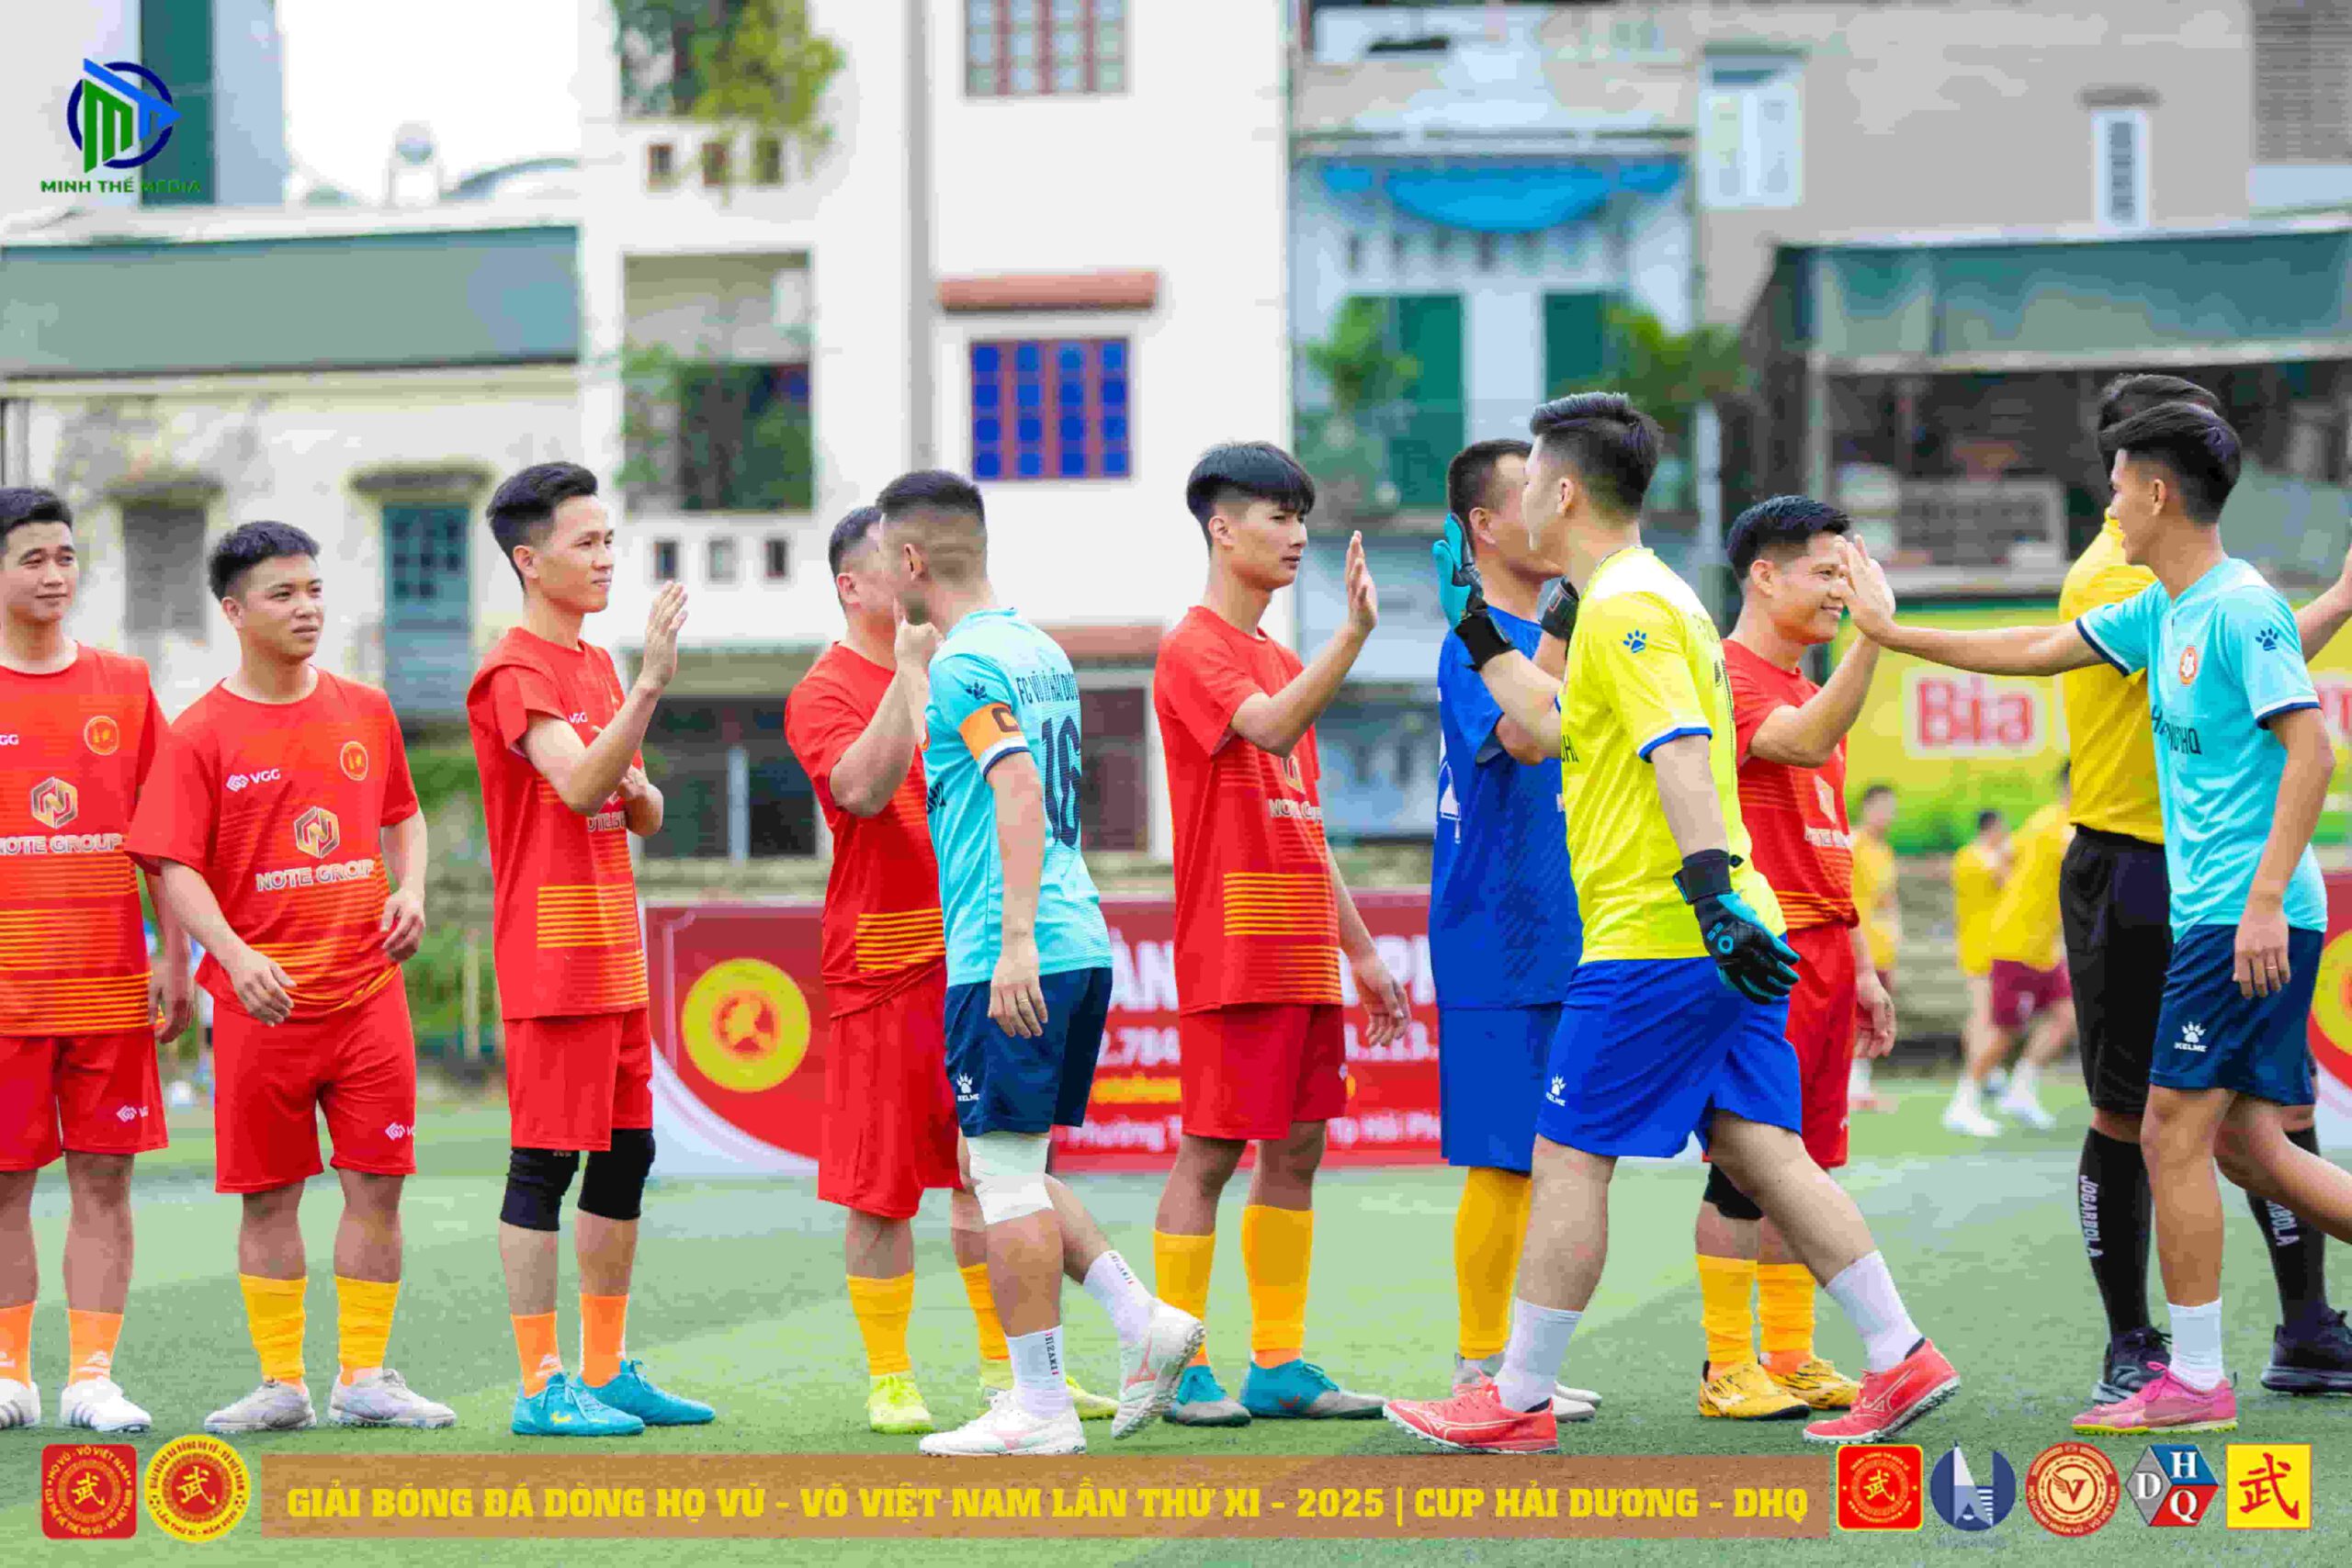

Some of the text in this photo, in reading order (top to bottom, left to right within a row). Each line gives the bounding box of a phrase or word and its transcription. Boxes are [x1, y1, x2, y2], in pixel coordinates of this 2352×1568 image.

[1916, 676, 2035, 747] Bia
[0, 734, 19, 746] GG
[250, 768, 281, 784] VGG
[1041, 715, 1081, 849] 16
[50, 833, 123, 853] GROUP
[255, 866, 313, 892] NOTE
